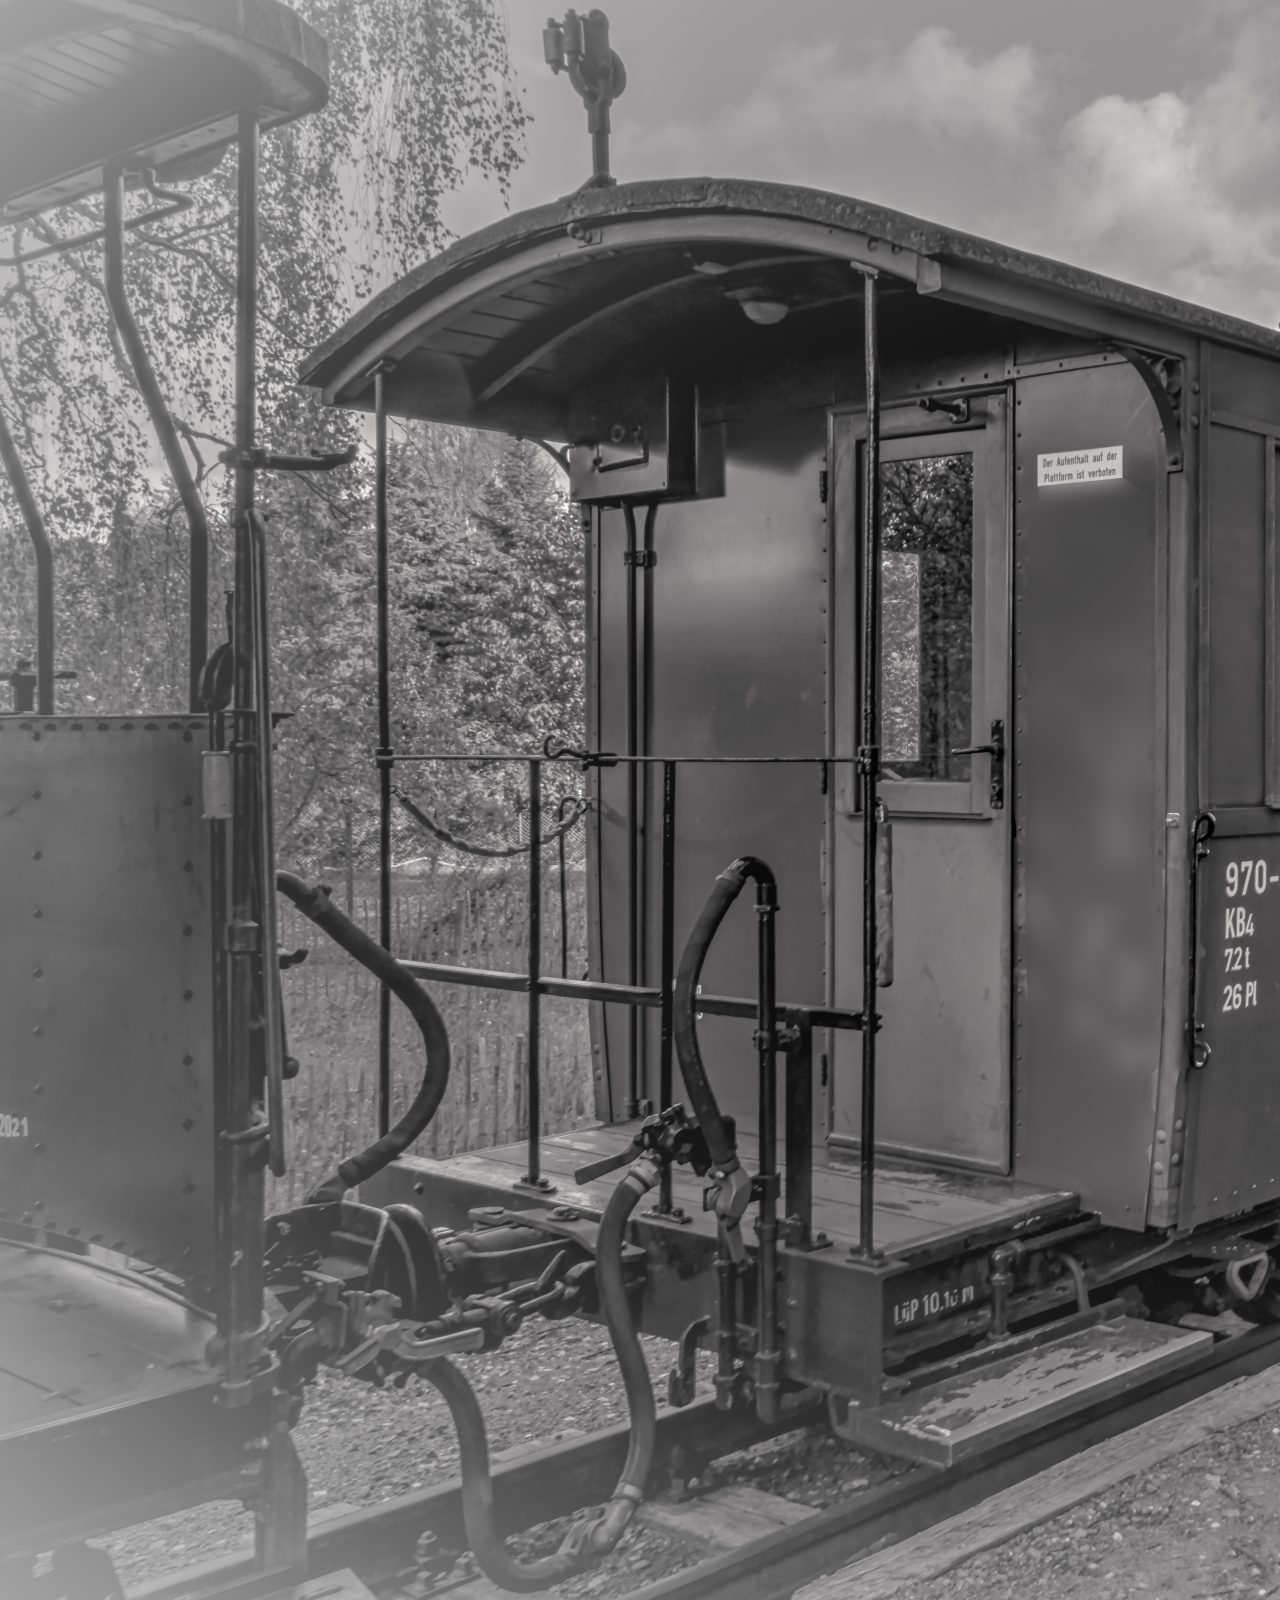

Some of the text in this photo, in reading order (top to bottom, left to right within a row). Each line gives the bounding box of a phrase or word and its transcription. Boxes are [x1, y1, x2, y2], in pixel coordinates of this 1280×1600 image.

[1043, 451, 1117, 468] Der Aufenthalt auf der
[1044, 468, 1116, 483] Plattform ist verboten
[1224, 906, 1255, 940] KB4
[1222, 983, 1243, 1012] 26
